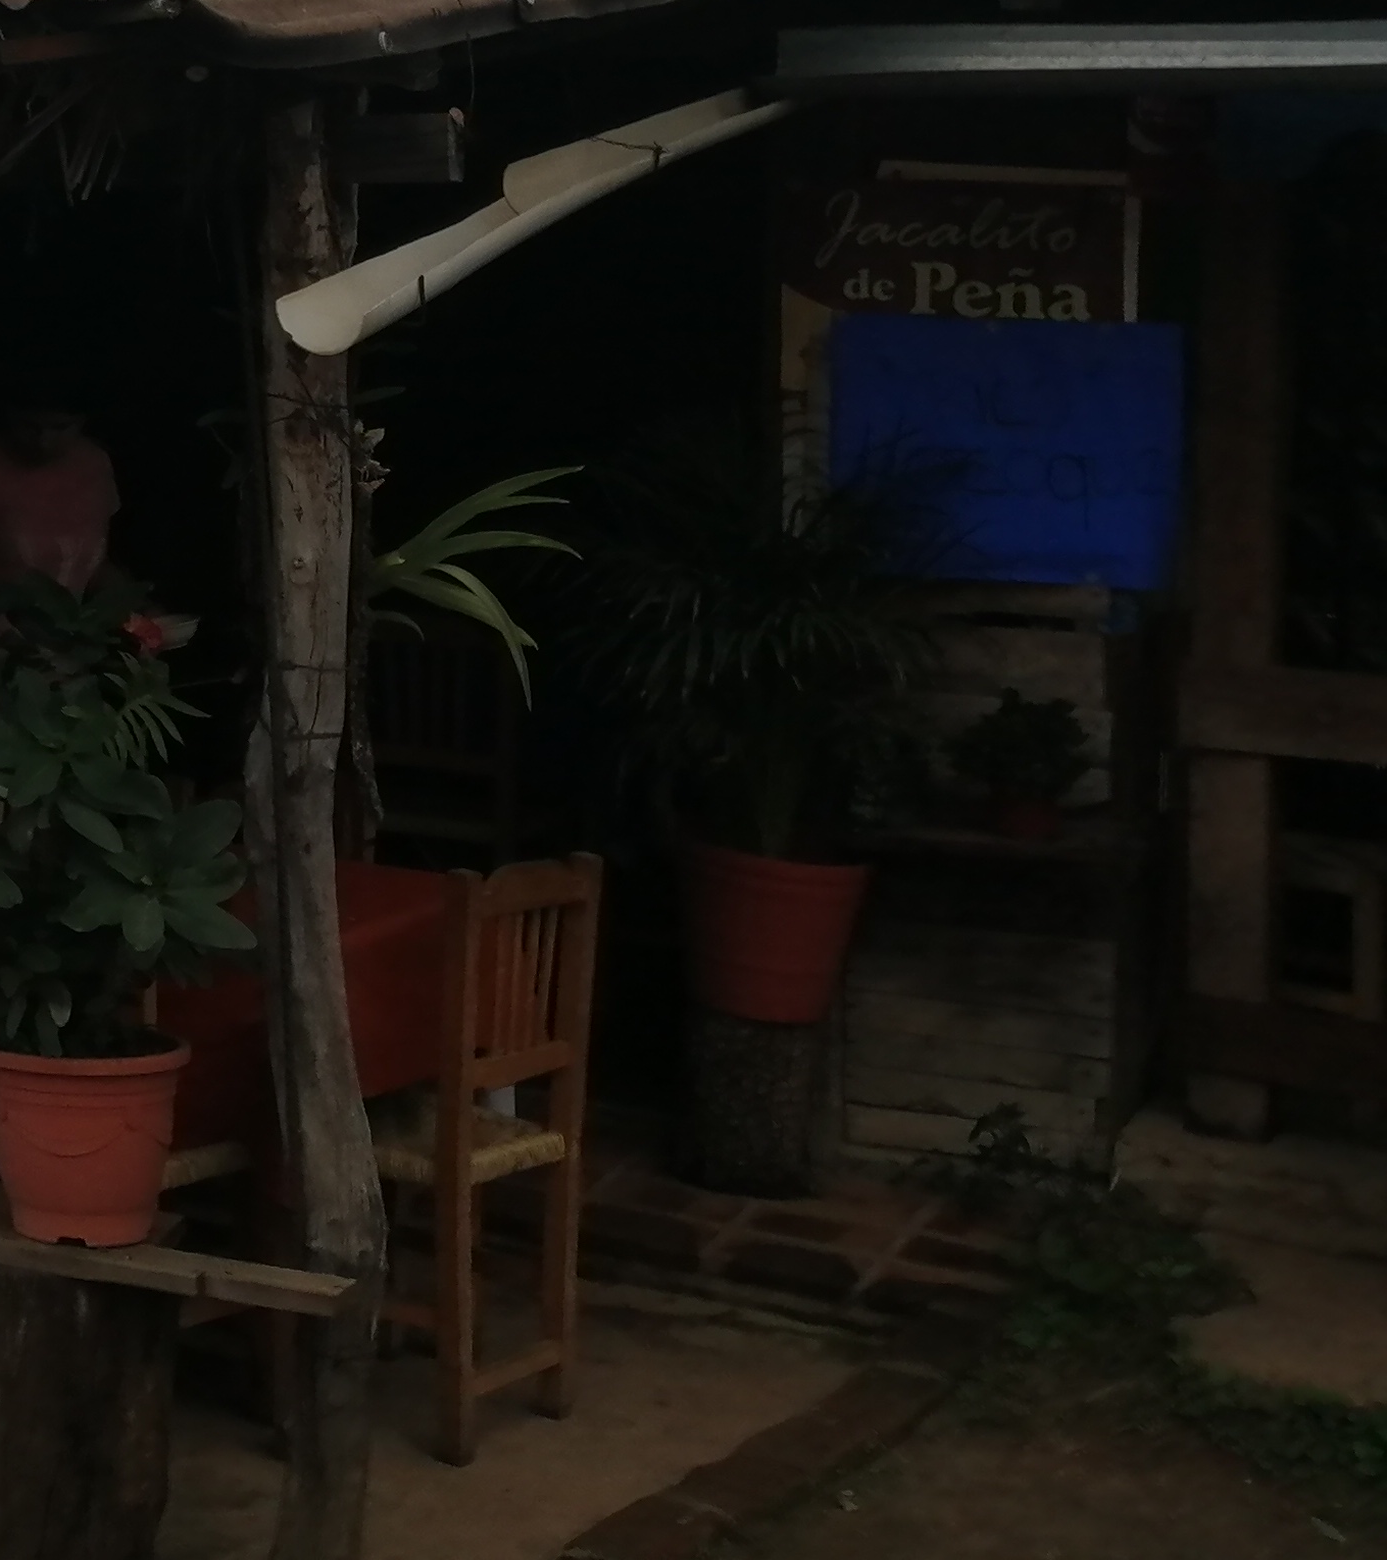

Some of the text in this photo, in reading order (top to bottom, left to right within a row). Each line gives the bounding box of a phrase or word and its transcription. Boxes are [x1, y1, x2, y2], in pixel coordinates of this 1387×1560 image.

[813, 188, 1078, 270] Jacalito
[842, 260, 1092, 322] de Peña
